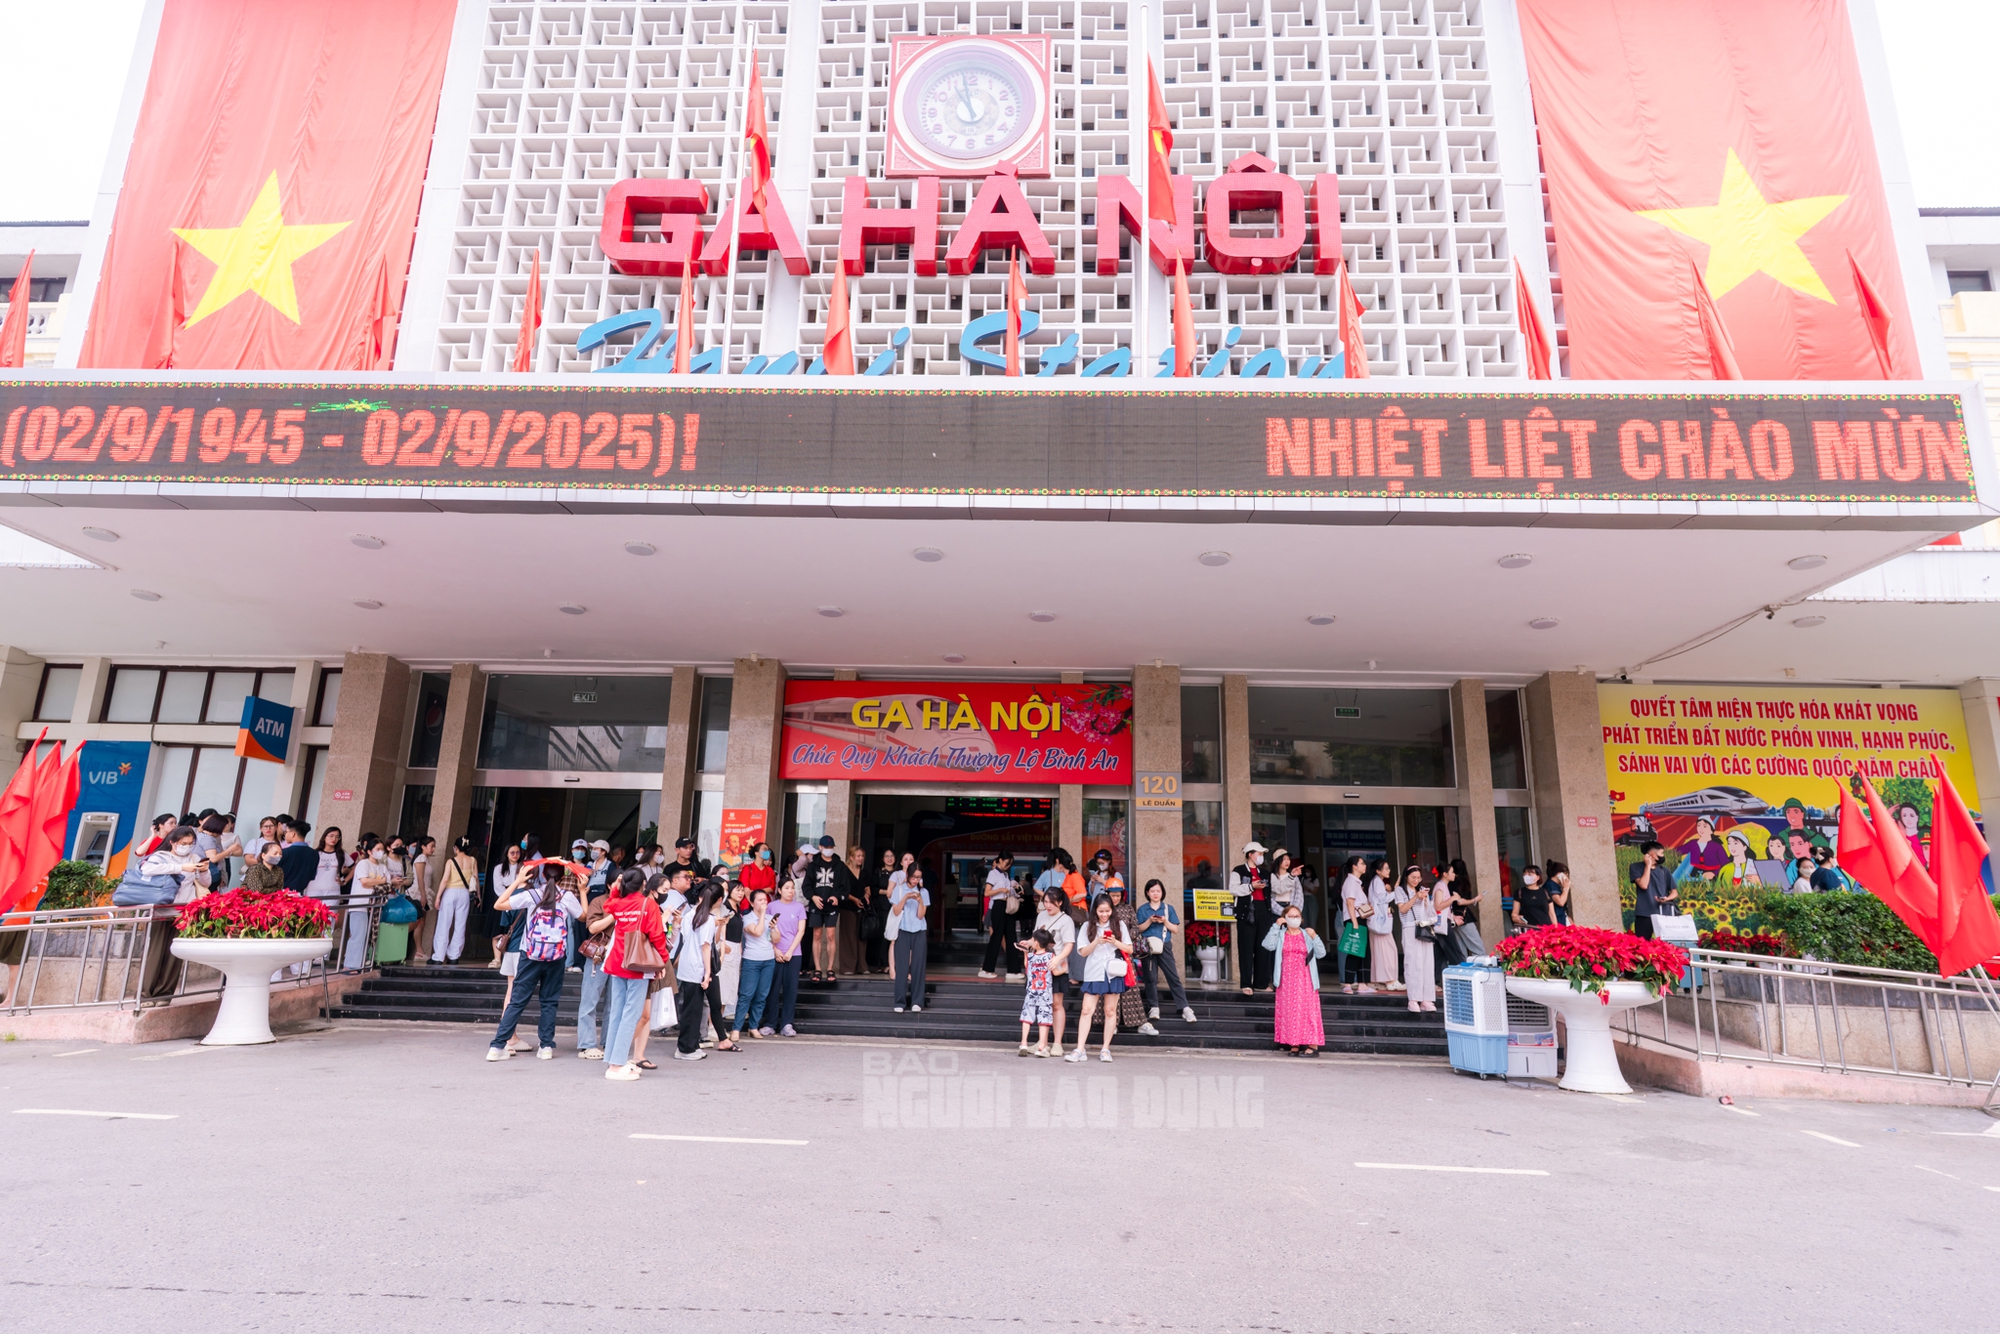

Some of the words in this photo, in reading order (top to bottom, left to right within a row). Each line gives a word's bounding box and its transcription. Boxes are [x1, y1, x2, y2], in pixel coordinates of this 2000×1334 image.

[988, 78, 994, 90] 1
[932, 91, 948, 102] 10
[999, 89, 1009, 101] 2
[927, 107, 938, 118] 9
[1004, 105, 1015, 117] 3
[932, 123, 943, 134] 8
[997, 121, 1009, 133] 4
[947, 134, 957, 146] 7
[965, 138, 976, 149] 6
[984, 134, 995, 145] 5
[600, 178, 811, 277] GA
[839, 159, 1056, 277] HÀ
[1096, 151, 1346, 277] NỘI
[1, 405, 307, 468] (02/9/1945
[321, 434, 345, 448] -
[361, 408, 700, 478] 02/9/2025)!
[1265, 405, 1448, 492] NHIỆT
[1467, 405, 1598, 493] LIỆT
[1618, 407, 1796, 481] CHÀO
[574, 693, 597, 702] EXIT
[1630, 694, 1676, 719] QUYẾT
[1680, 697, 1713, 718] TÂM
[1717, 697, 1752, 722] HIỆN
[1756, 699, 1796, 723] THỰC
[1799, 699, 1831, 720] HÓA
[1834, 699, 1872, 721] KHÁT
[1876, 702, 1918, 724] VỌNG
[851, 699, 913, 730] GA
[922, 693, 981, 732] HÀ
[990, 695, 1063, 739] NỘI
[255, 717, 285, 738] ATM
[1602, 723, 1641, 744] PHÁT
[1645, 721, 1689, 745] TRIỂN
[1692, 722, 1721, 746] ĐẤT
[1725, 725, 1768, 747] NƯỚC
[1771, 724, 1814, 748] PHỒN
[1817, 731, 1859, 751] VINH,
[1862, 731, 1905, 753] HẠNH
[1908, 728, 1955, 752] PHÚC,
[791, 742, 836, 775] Chúc
[839, 743, 880, 773] Quý
[881, 746, 945, 768] Khách
[944, 746, 1010, 774] Thượng
[1014, 747, 1039, 773] Lộ
[1041, 747, 1092, 771] Bình
[1091, 748, 1119, 771] An
[1618, 751, 1660, 773] SÁNH
[1663, 756, 1689, 774] VAI
[1692, 753, 1717, 774] VỚI
[1721, 754, 1752, 775] CÁC
[1756, 754, 1809, 777] CƯỜNG
[1812, 753, 1854, 778] QUỐC
[1857, 755, 1895, 777] NĂM
[88, 771, 119, 785] VIB
[1140, 775, 1178, 795] 120
[1142, 799, 1152, 807] LÊ
